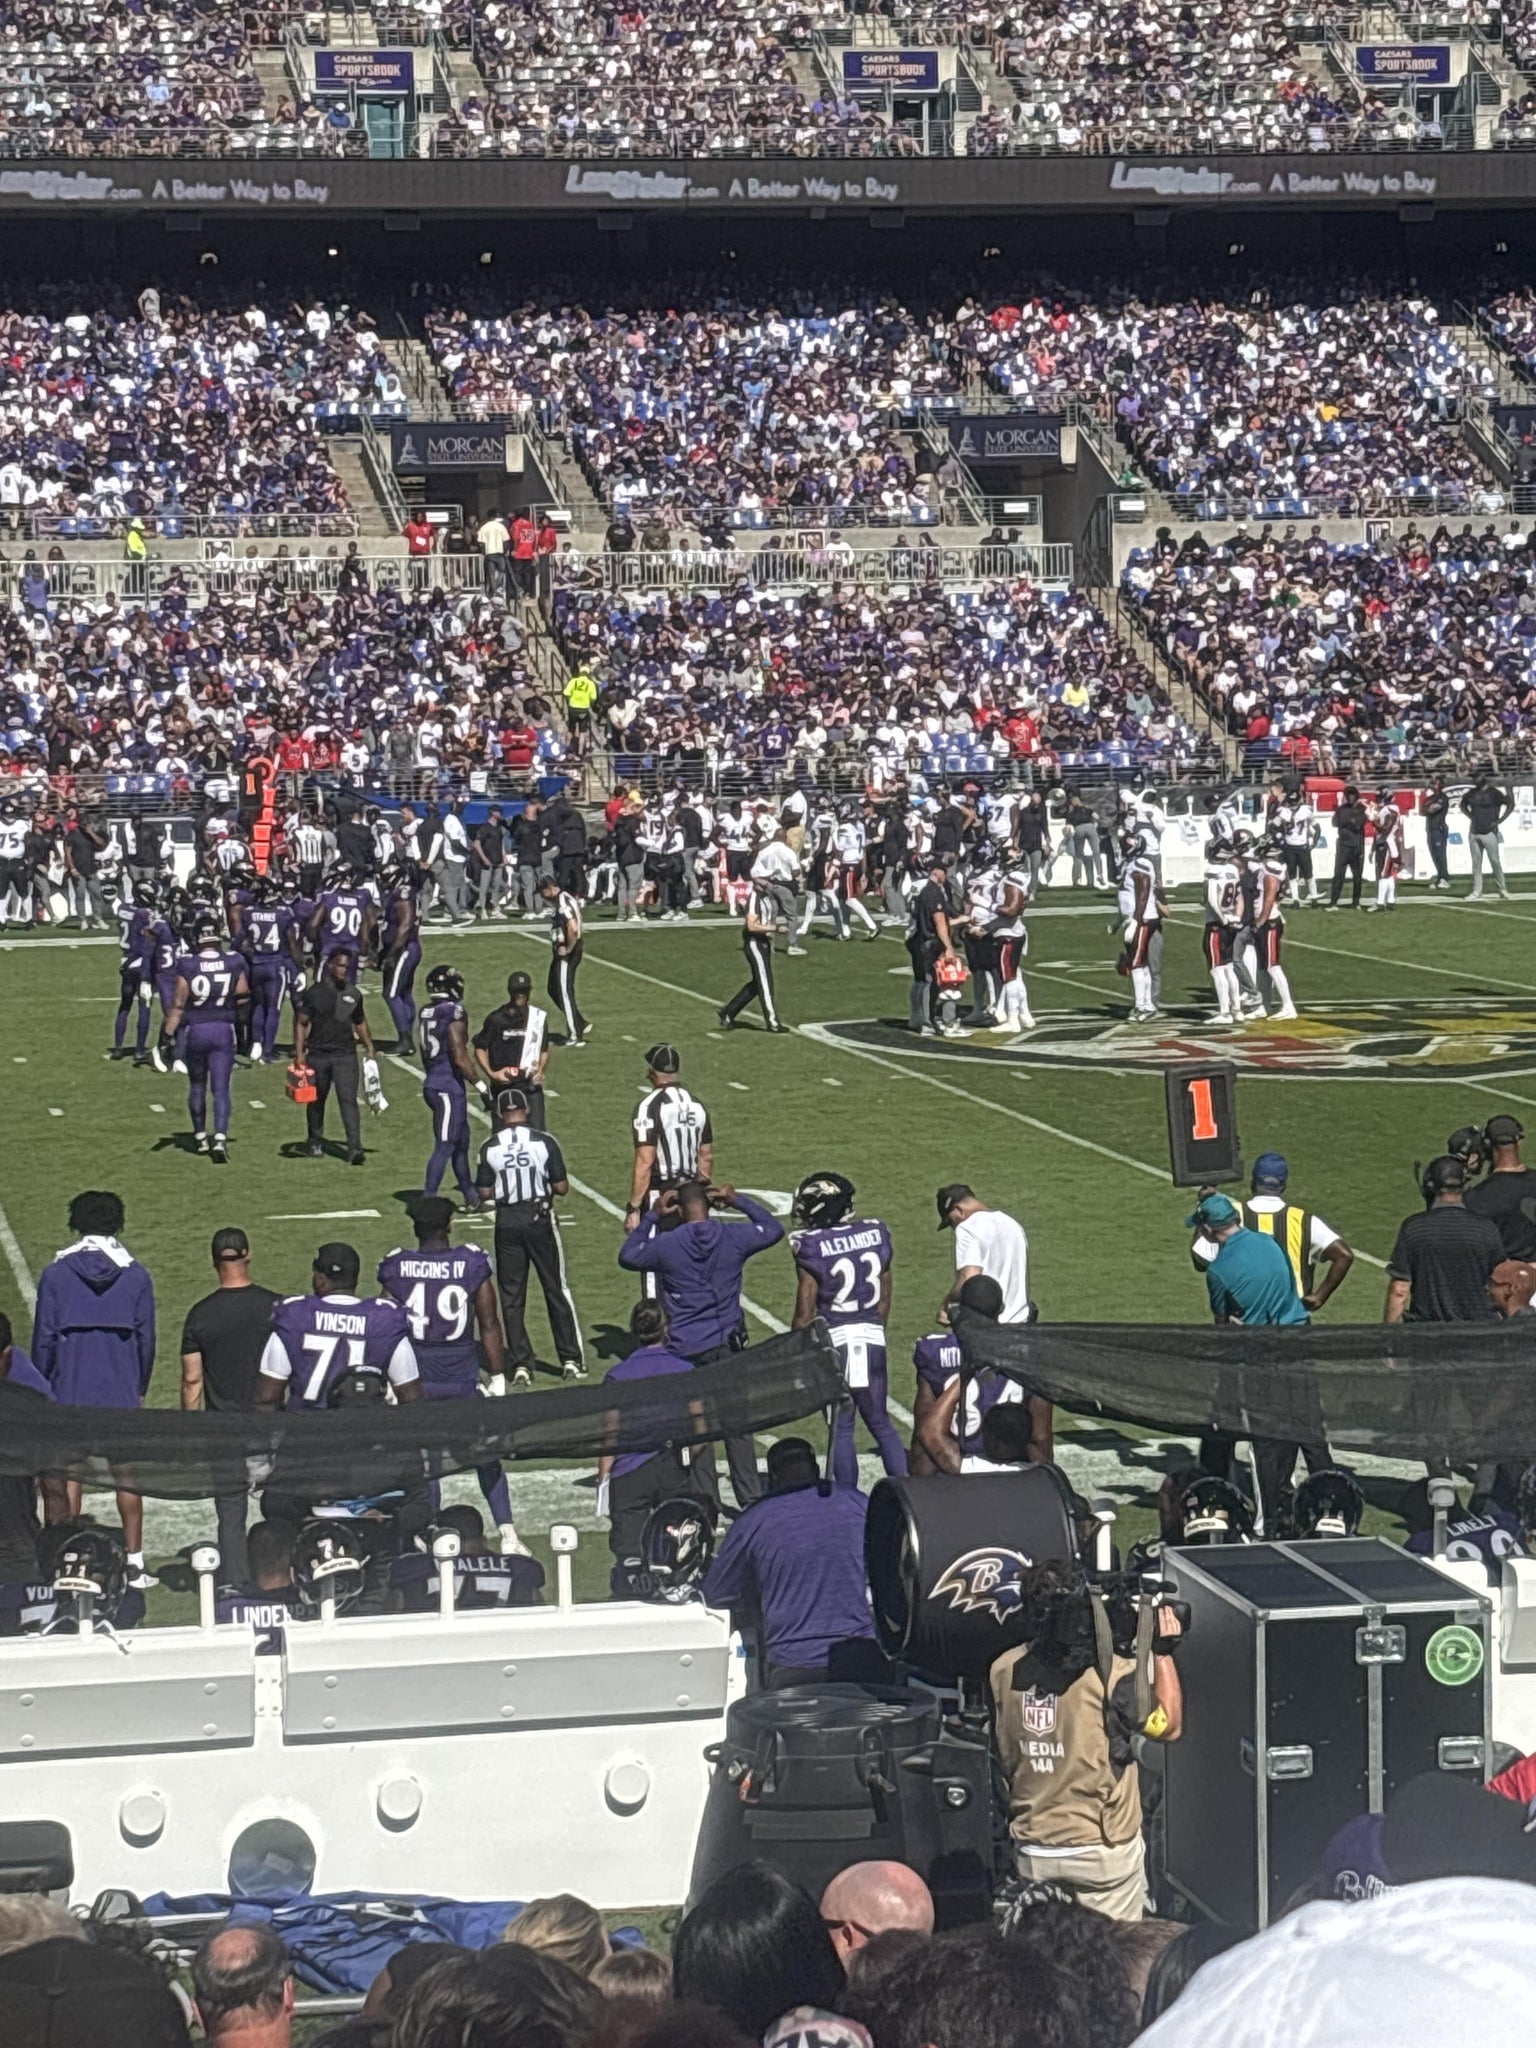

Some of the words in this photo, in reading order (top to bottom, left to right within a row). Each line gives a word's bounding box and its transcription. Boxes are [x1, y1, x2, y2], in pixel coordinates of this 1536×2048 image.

[333, 55, 374, 63] CAESARS
[861, 55, 900, 63] CAESARS
[1374, 50, 1412, 58] CAESARS
[334, 64, 401, 76] SPORTSBOOK
[861, 64, 926, 76] SPORTSBOOK
[1374, 59, 1438, 71] SPORTSBOOK
[152, 180, 168, 199] A
[172, 180, 226, 200] Better
[230, 180, 269, 204] Way
[273, 183, 291, 200] to
[294, 179, 328, 205] Buy
[728, 178, 744, 197] A
[748, 178, 800, 198] Better
[803, 177, 841, 201] Way
[844, 181, 861, 197] to
[865, 178, 898, 202] Buy
[1269, 174, 1285, 193] A
[1288, 174, 1340, 192] Better
[1343, 173, 1381, 195] Way
[1383, 176, 1400, 192] to
[1404, 171, 1436, 194] Buy
[428, 437, 504, 453] MORGAN
[985, 430, 1059, 444] MORGAN
[245, 773, 256, 795] 1
[352, 774, 364, 788] 31
[330, 906, 362, 936] 90
[191, 973, 231, 1006] 97
[678, 1112, 696, 1126] 46
[1188, 1079, 1218, 1140] 1
[503, 1152, 530, 1168] 26
[820, 1229, 883, 1258] ALEXANDER
[400, 1260, 450, 1279] HIGGINS
[453, 1261, 466, 1279] IV
[829, 1252, 882, 1312] 23
[404, 1282, 469, 1341] 49
[315, 1311, 367, 1336] VINSON
[434, 1556, 511, 1573] ALELE
[1026, 1708, 1053, 1729] NFL
